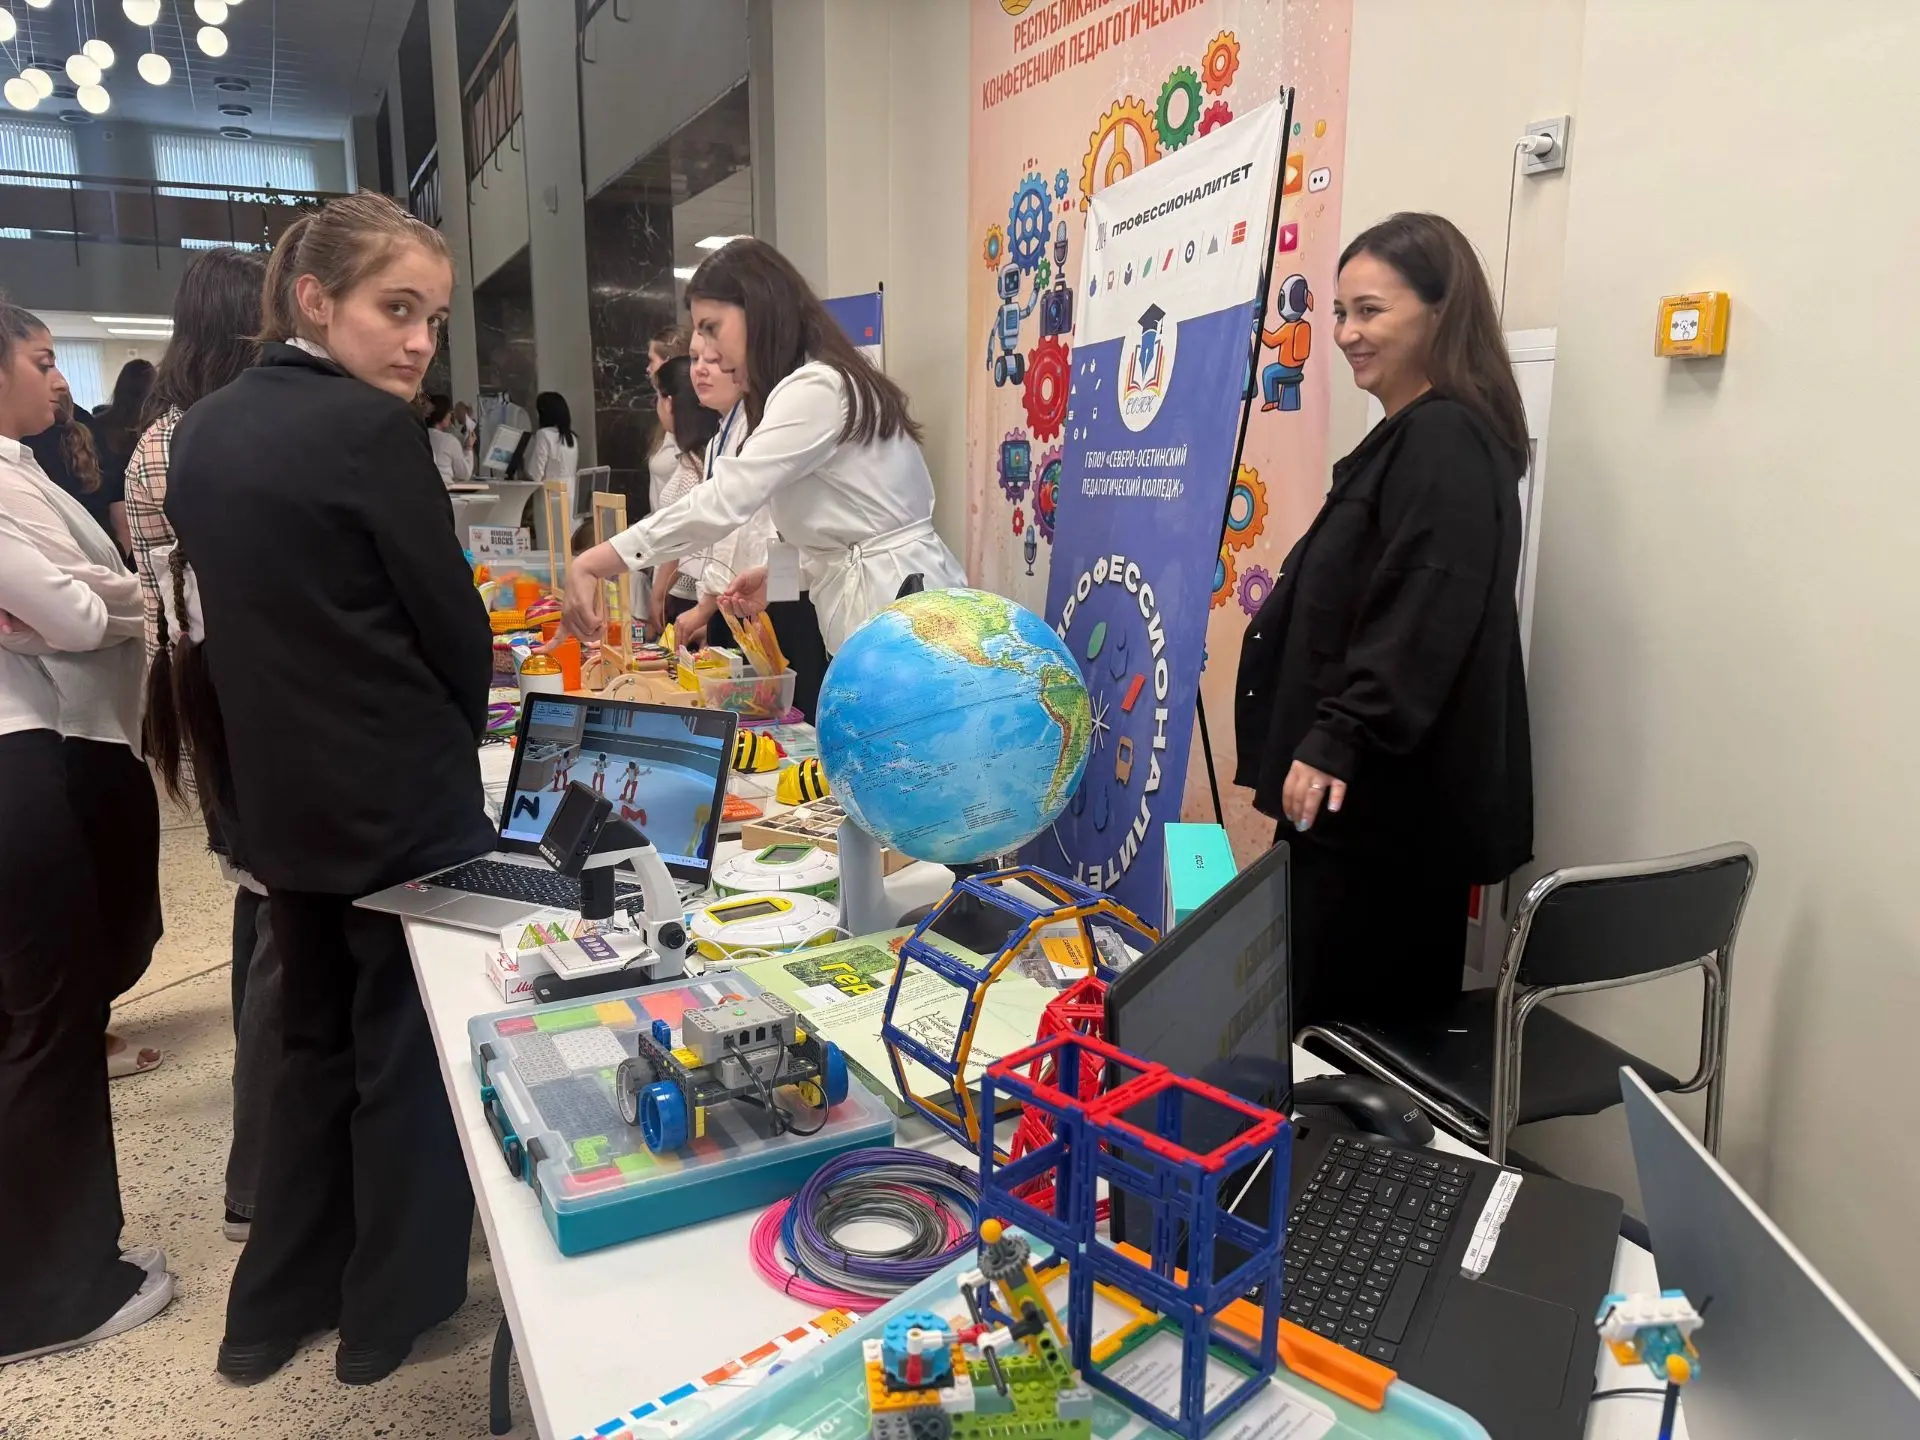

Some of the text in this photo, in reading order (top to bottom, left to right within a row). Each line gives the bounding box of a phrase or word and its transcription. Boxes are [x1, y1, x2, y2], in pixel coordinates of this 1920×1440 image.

[982, 40, 1066, 110] КОНФЕРЕНЦИЯ
[1112, 162, 1253, 237] ПРОФЕССИОНАЛИТЕТ
[1084, 443, 1187, 468] ГБПОУ «СЕВЕРО-ОСЕТИНСКИЙ
[1081, 476, 1184, 501] ПЕДАГОГИЧЕСКИЙ КОЛЛЕДЖ»
[817, 961, 877, 996] Гер
